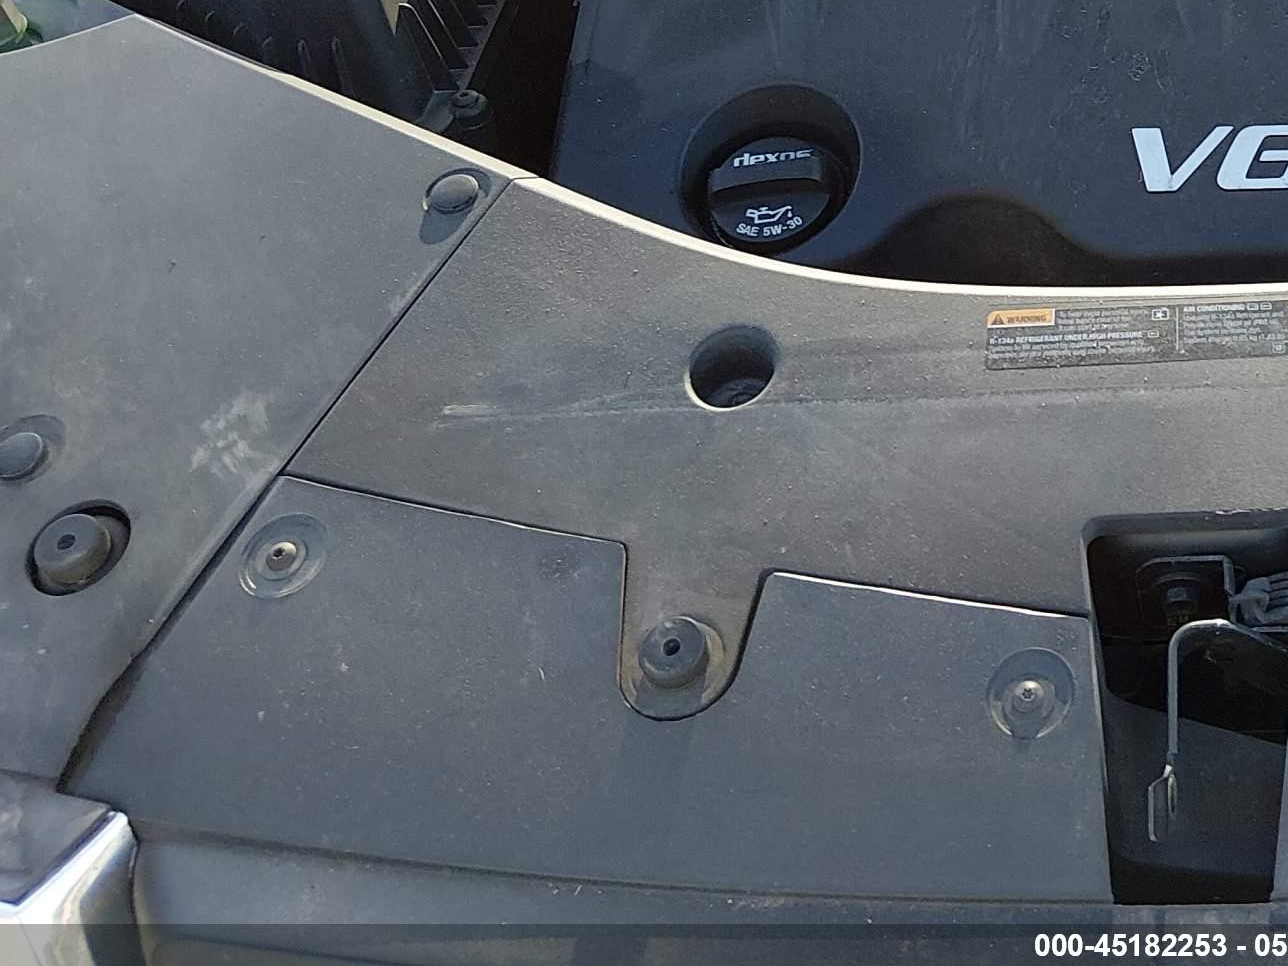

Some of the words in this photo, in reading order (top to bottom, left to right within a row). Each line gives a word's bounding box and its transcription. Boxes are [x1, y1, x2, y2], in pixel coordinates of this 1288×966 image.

[736, 222, 760, 237] SAE
[763, 216, 804, 237] 5W-30
[1007, 314, 1048, 323] WARNING
